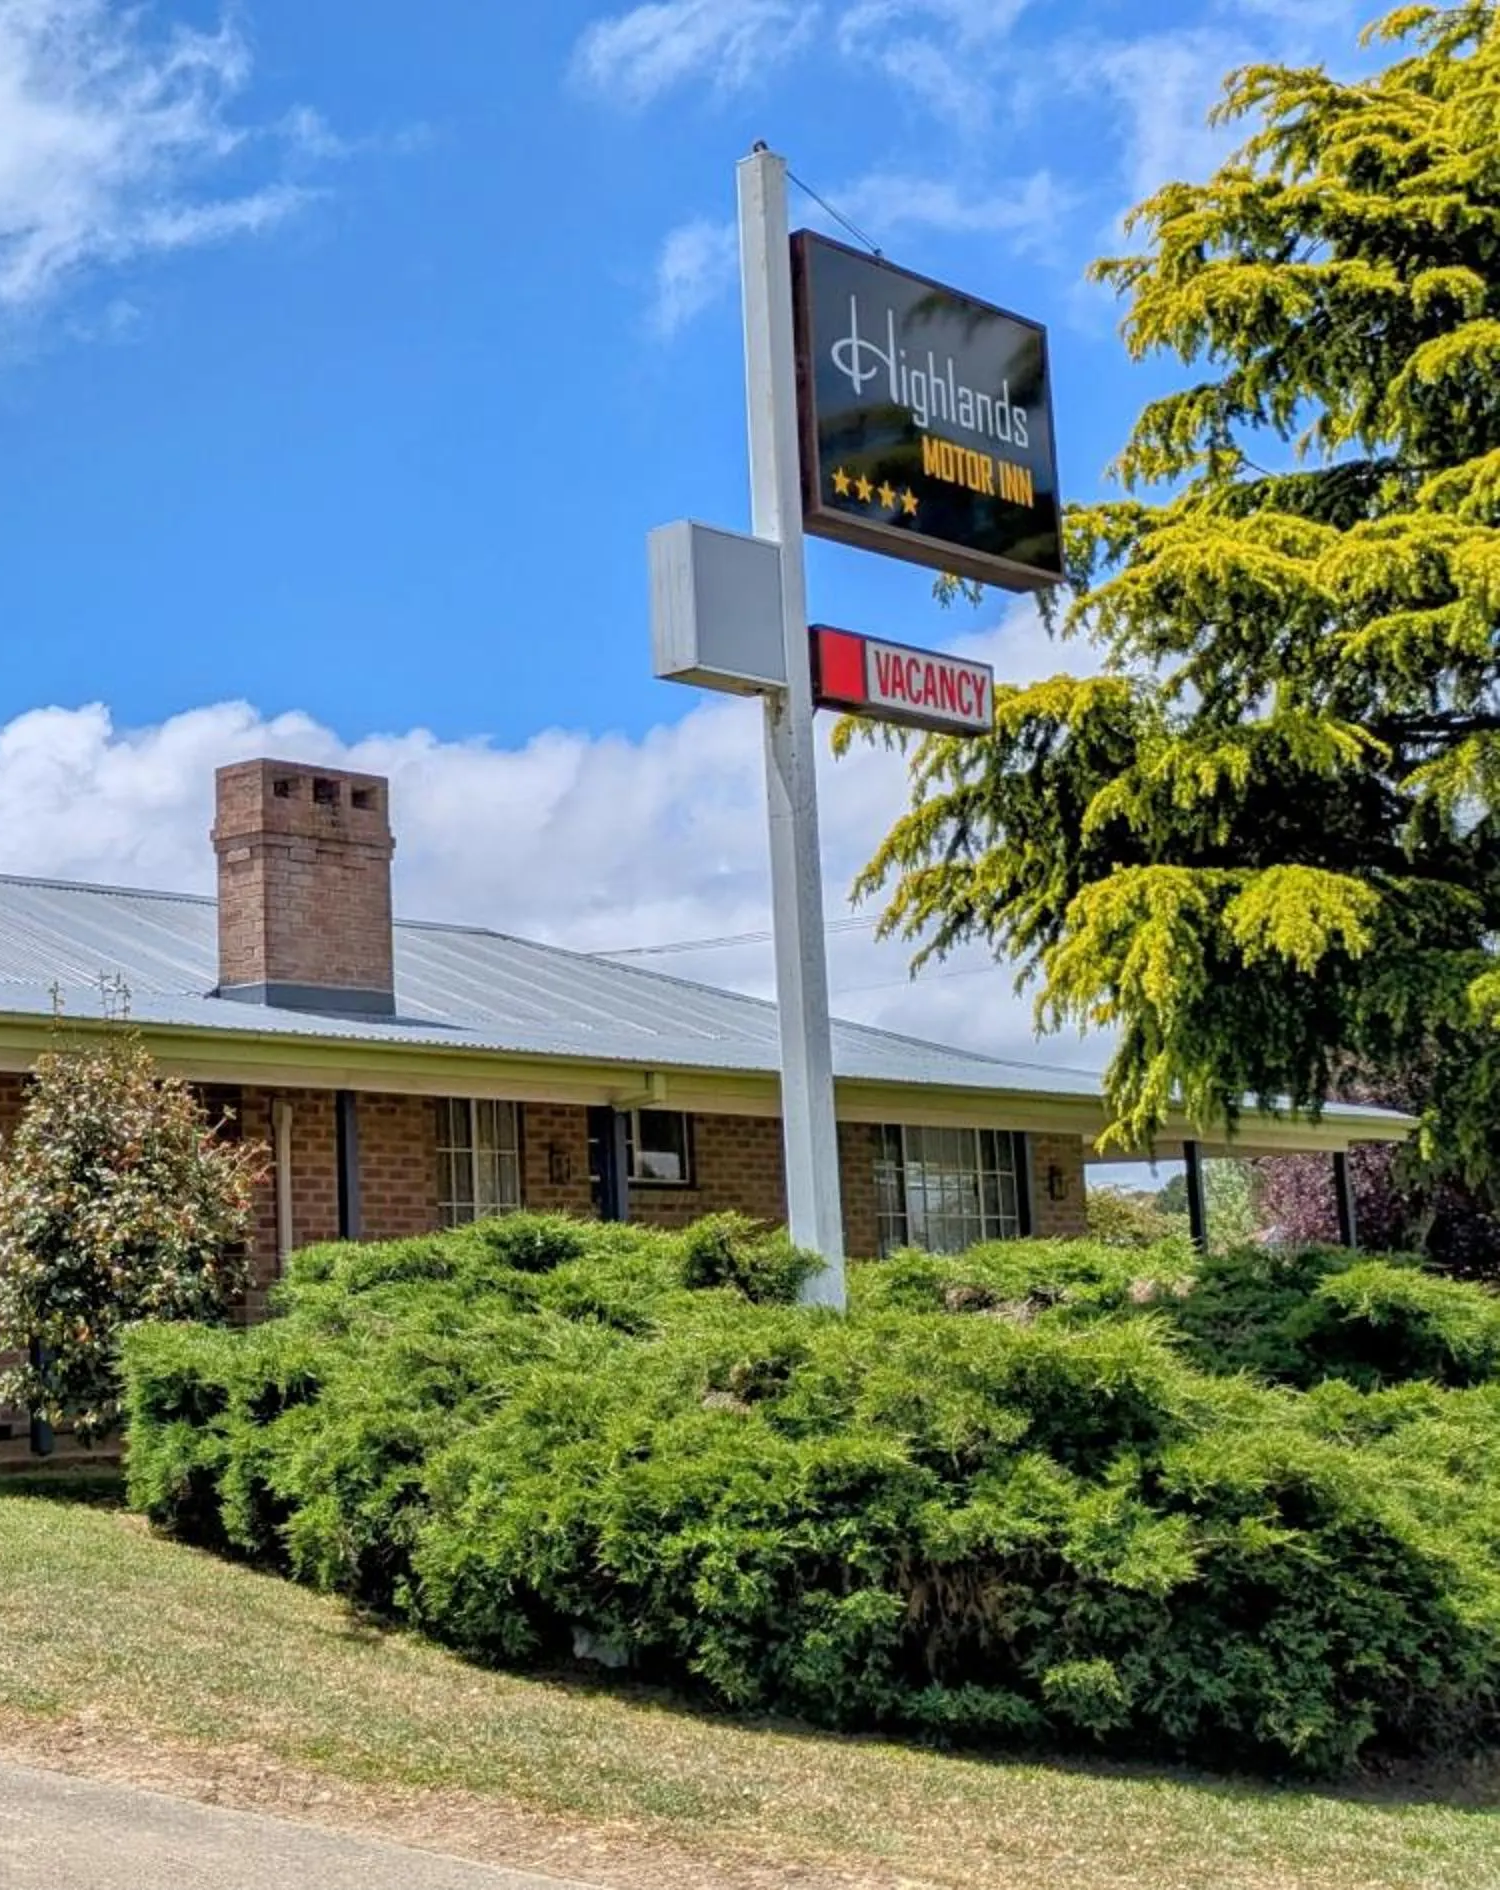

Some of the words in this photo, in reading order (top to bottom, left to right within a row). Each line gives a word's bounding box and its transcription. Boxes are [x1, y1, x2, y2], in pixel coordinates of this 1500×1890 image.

[831, 295, 1029, 448] Highlands
[923, 435, 995, 495] MOTOR
[998, 459, 1034, 507] INN
[875, 650, 986, 718] VACANCY
